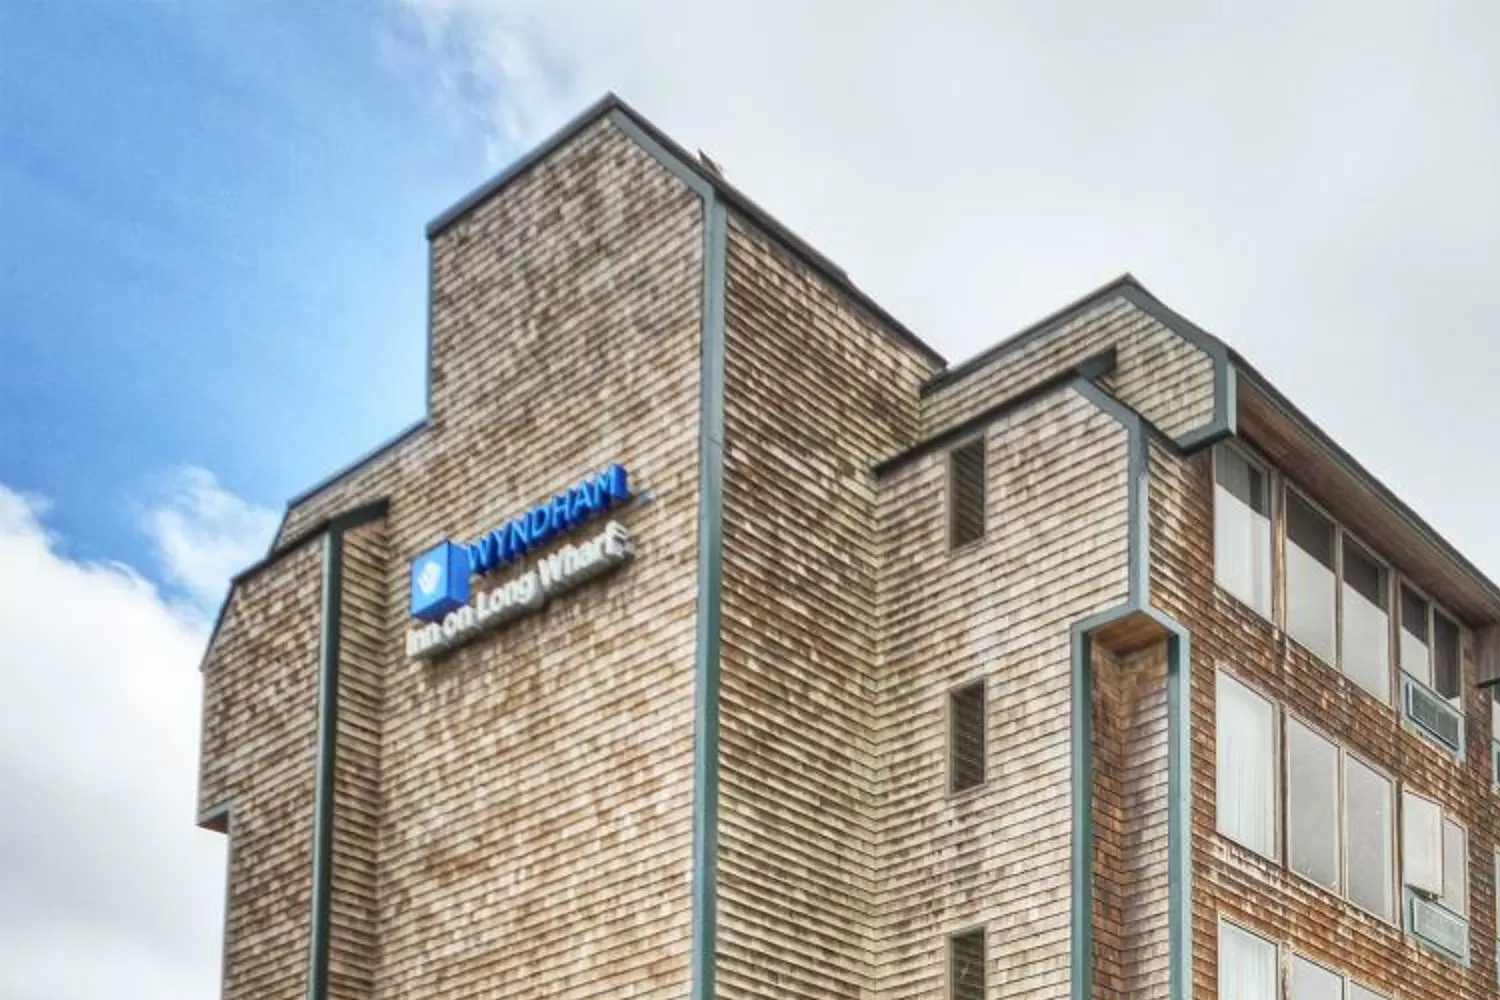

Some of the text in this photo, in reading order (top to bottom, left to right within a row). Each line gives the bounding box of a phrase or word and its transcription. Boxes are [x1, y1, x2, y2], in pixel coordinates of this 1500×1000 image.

[467, 463, 629, 575] WYNDHAM
[406, 621, 443, 657] Inn
[443, 604, 474, 638] on
[477, 569, 541, 620] Long
